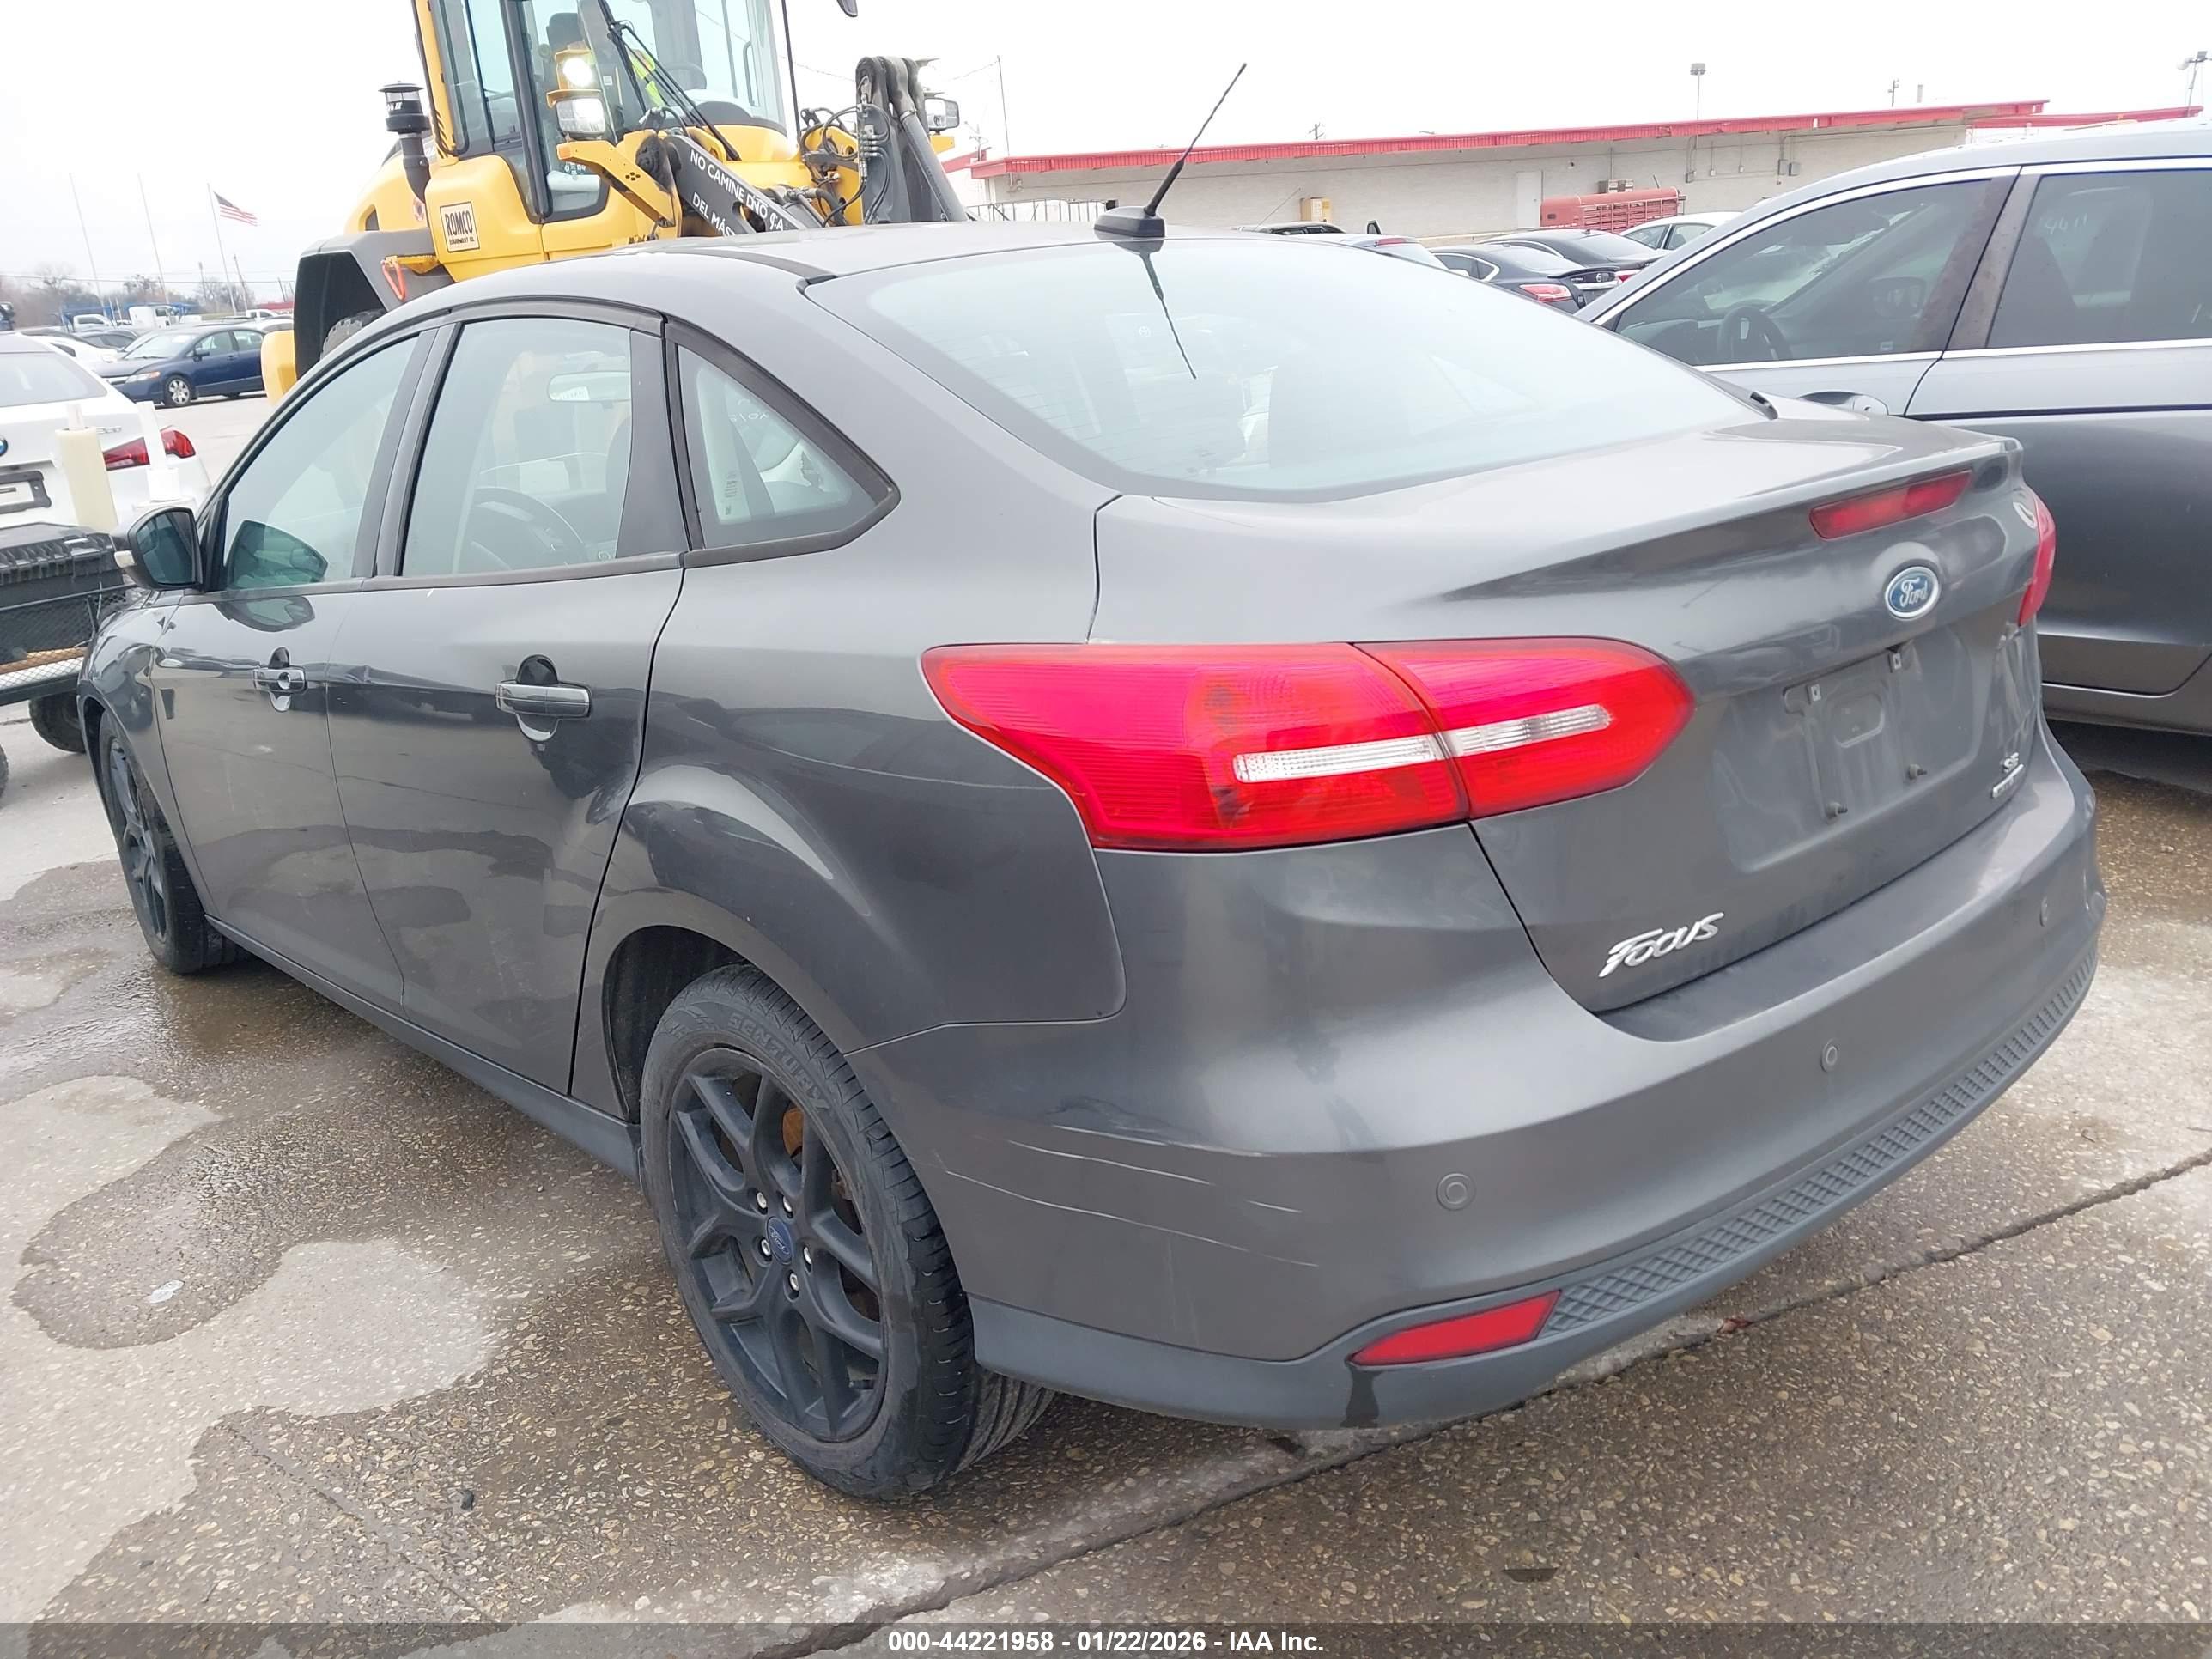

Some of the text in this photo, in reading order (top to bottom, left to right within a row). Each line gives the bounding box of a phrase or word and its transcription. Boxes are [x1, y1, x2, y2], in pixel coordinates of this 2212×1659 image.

[690, 149, 706, 171] NO
[707, 163, 745, 204] CAMINE
[692, 191, 710, 220] DEL
[445, 210, 473, 236] ROMCO
[1899, 576, 1929, 608] Ford
